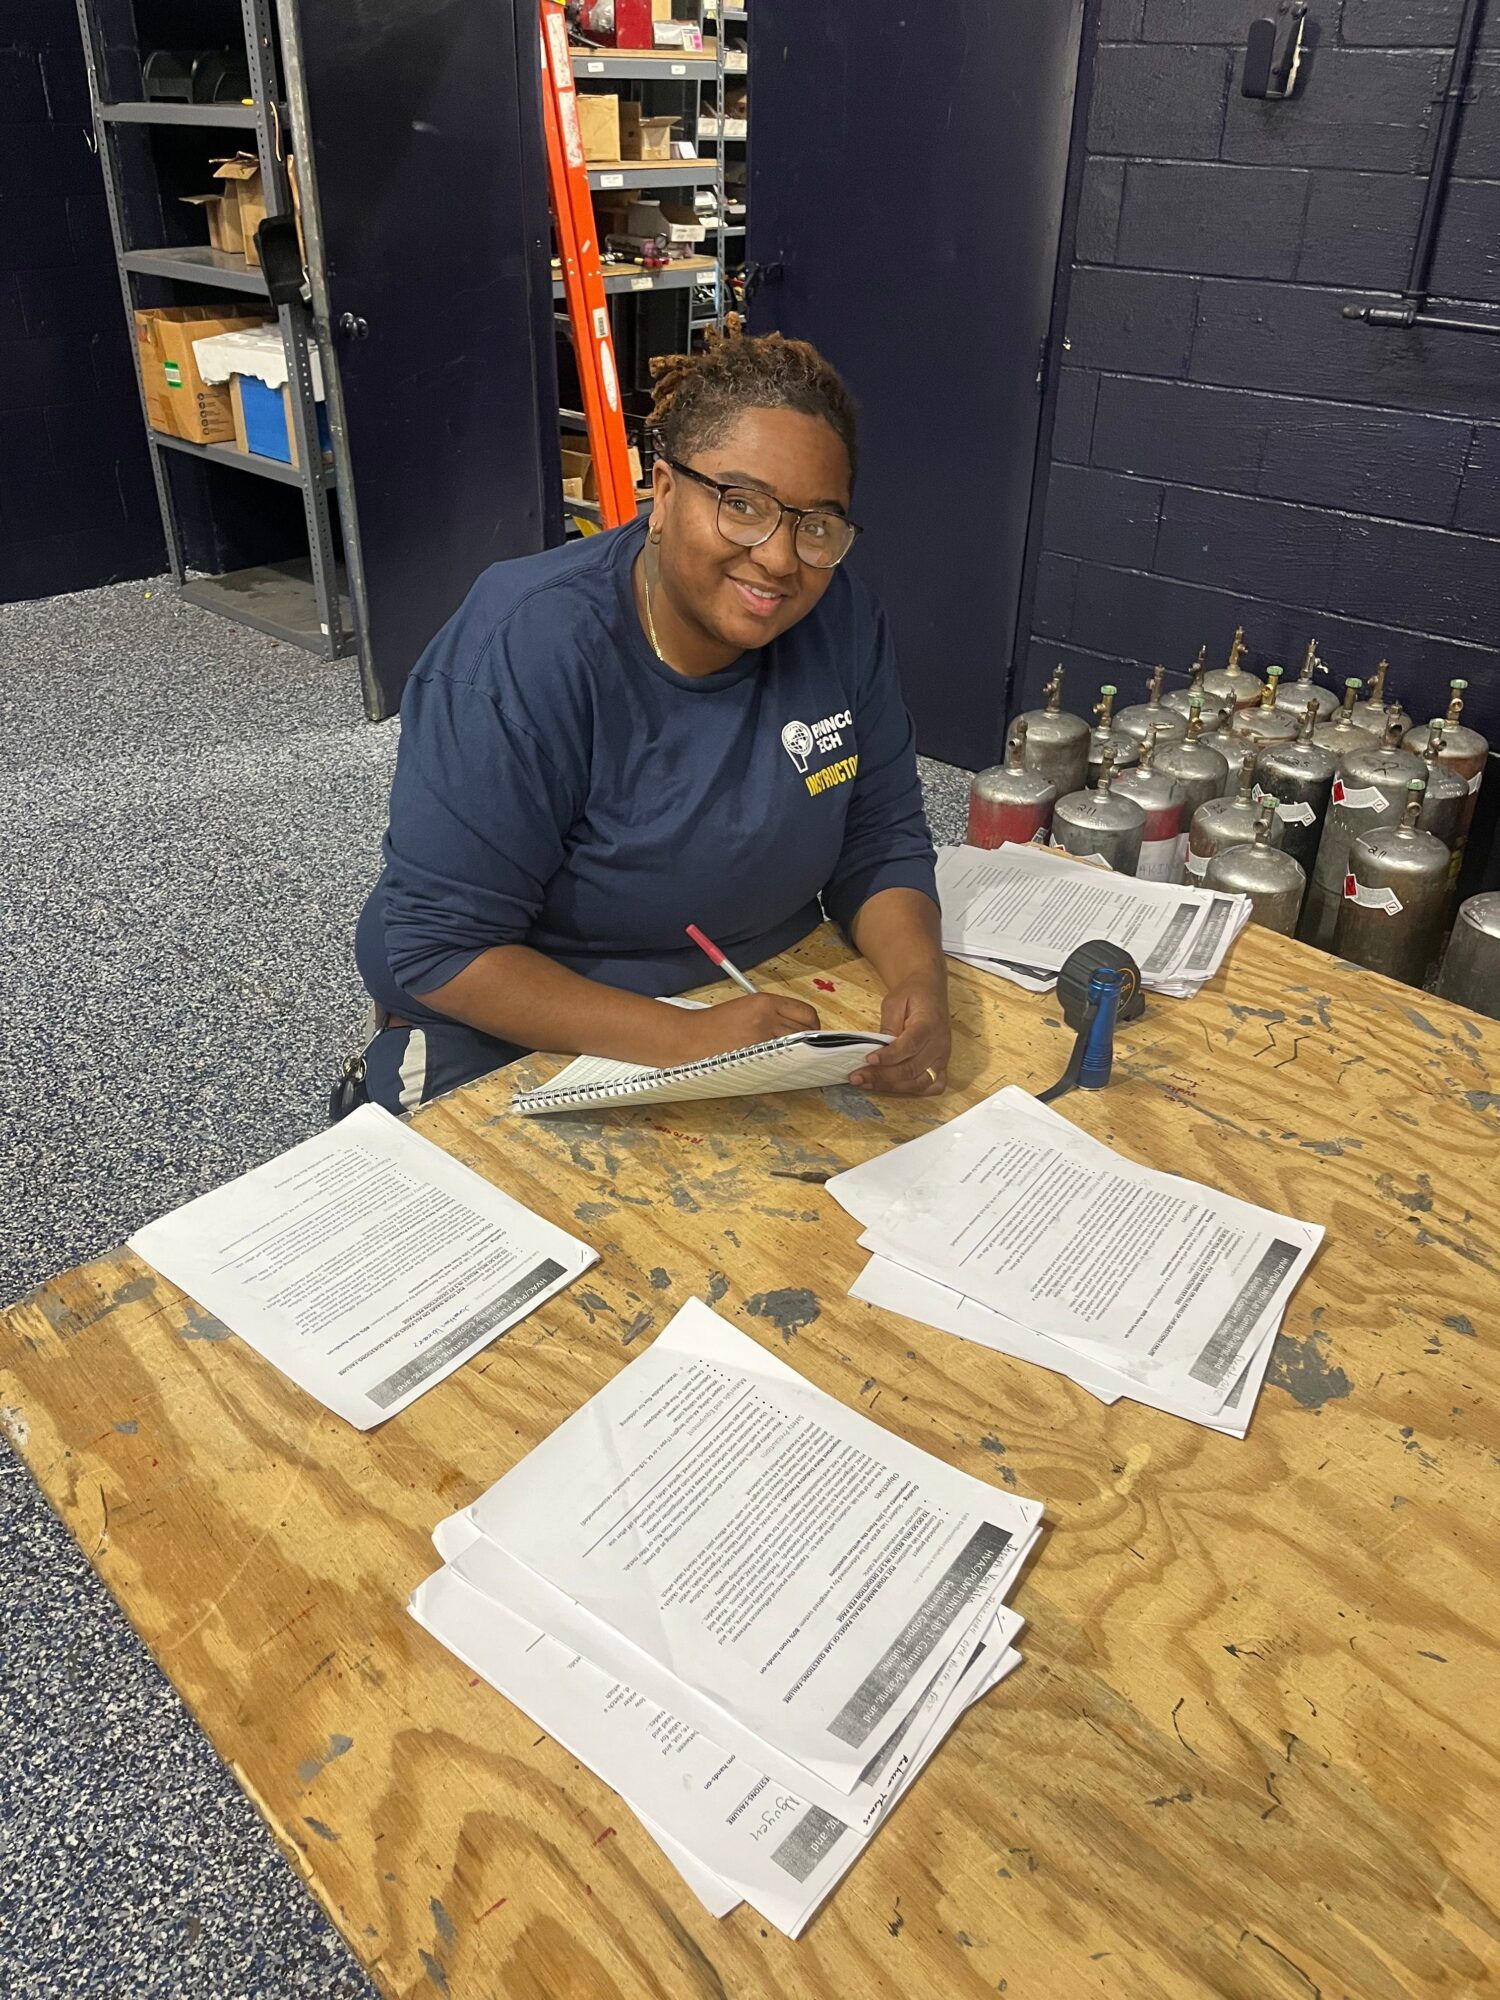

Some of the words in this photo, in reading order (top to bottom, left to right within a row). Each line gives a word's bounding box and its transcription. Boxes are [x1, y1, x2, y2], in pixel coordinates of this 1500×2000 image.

[805, 754, 859, 797] INSTRUCTO
[872, 1471, 900, 1500] Objectives
[958, 1547, 994, 1591] HVAC/PLM
[921, 1577, 954, 1616] Soldering
[942, 1588, 964, 1614] FUND
[901, 1613, 928, 1645] Copper
[929, 1615, 946, 1633] Lab
[877, 1642, 907, 1674] Tubing
[898, 1638, 928, 1674] Cutting,
[873, 1670, 905, 1707] Brazing,
[862, 1703, 880, 1724] and
[702, 1763, 729, 1791] hands-on
[724, 1774, 771, 1825] ESTIONS-FAILURE
[748, 1795, 800, 1841] Nguyen
[809, 1830, 827, 1853] and
